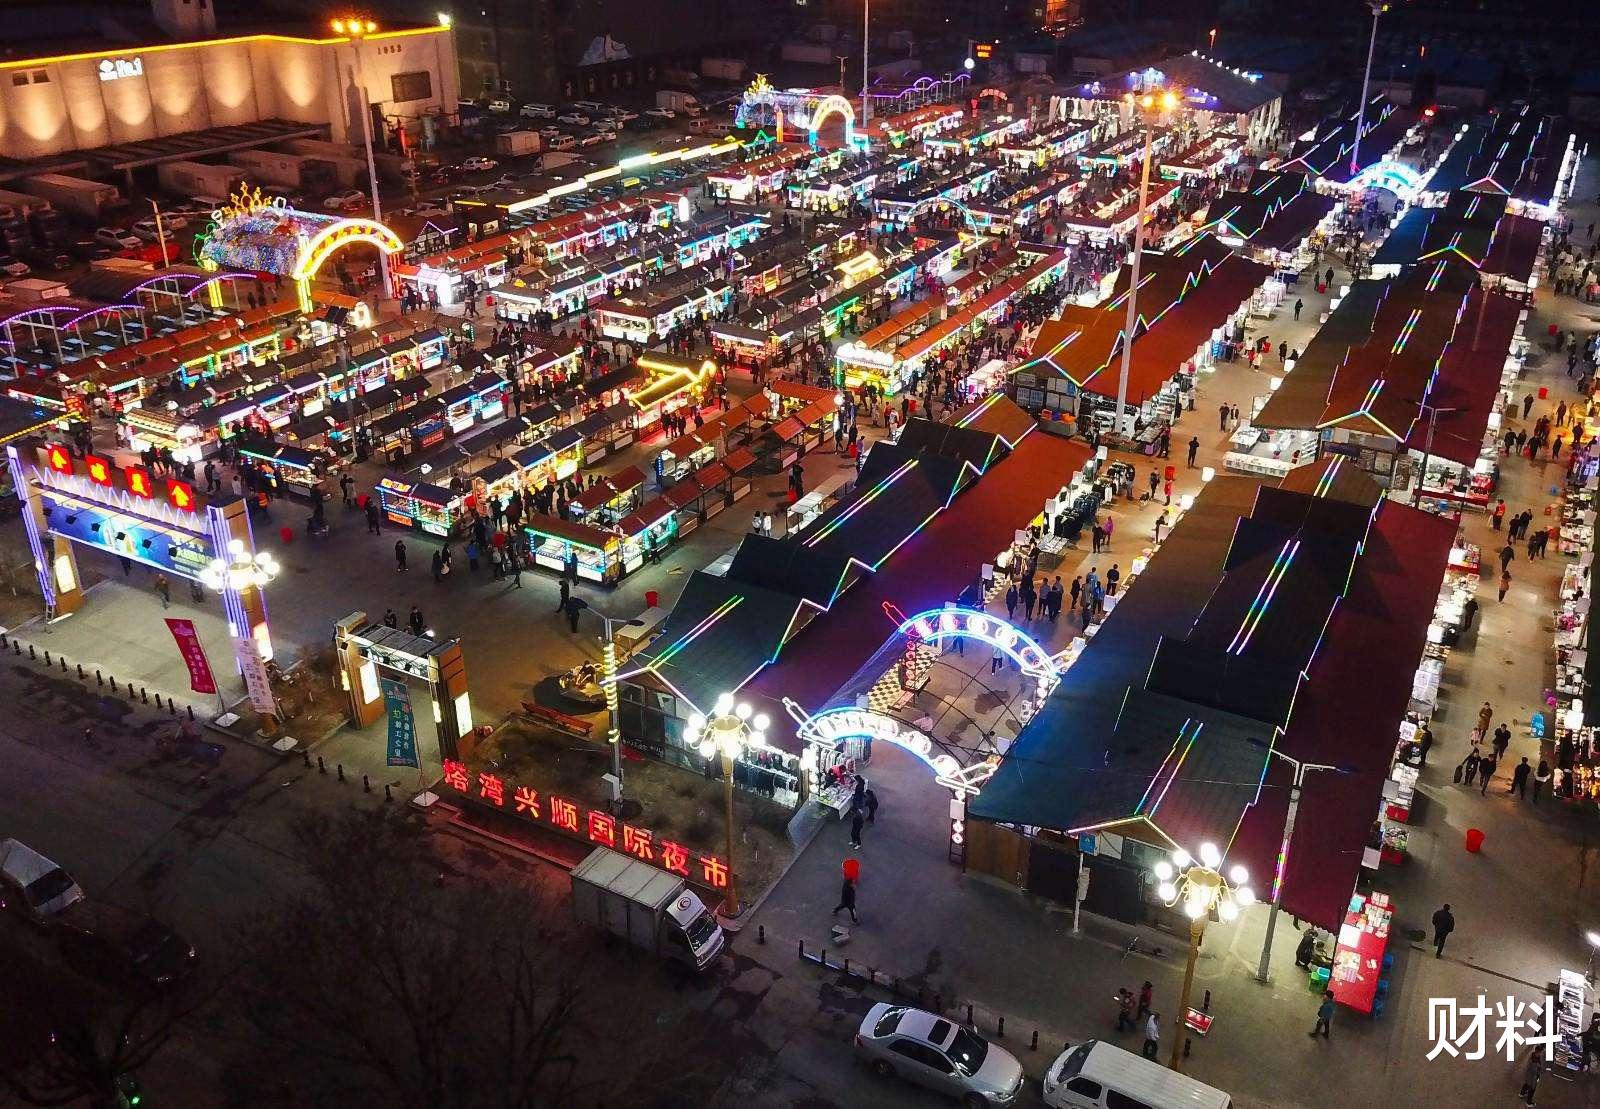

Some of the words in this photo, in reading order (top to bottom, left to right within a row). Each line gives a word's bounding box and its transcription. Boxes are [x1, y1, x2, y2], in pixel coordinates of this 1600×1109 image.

[441, 758, 729, 887] 塔湾兴顺国际夜市
